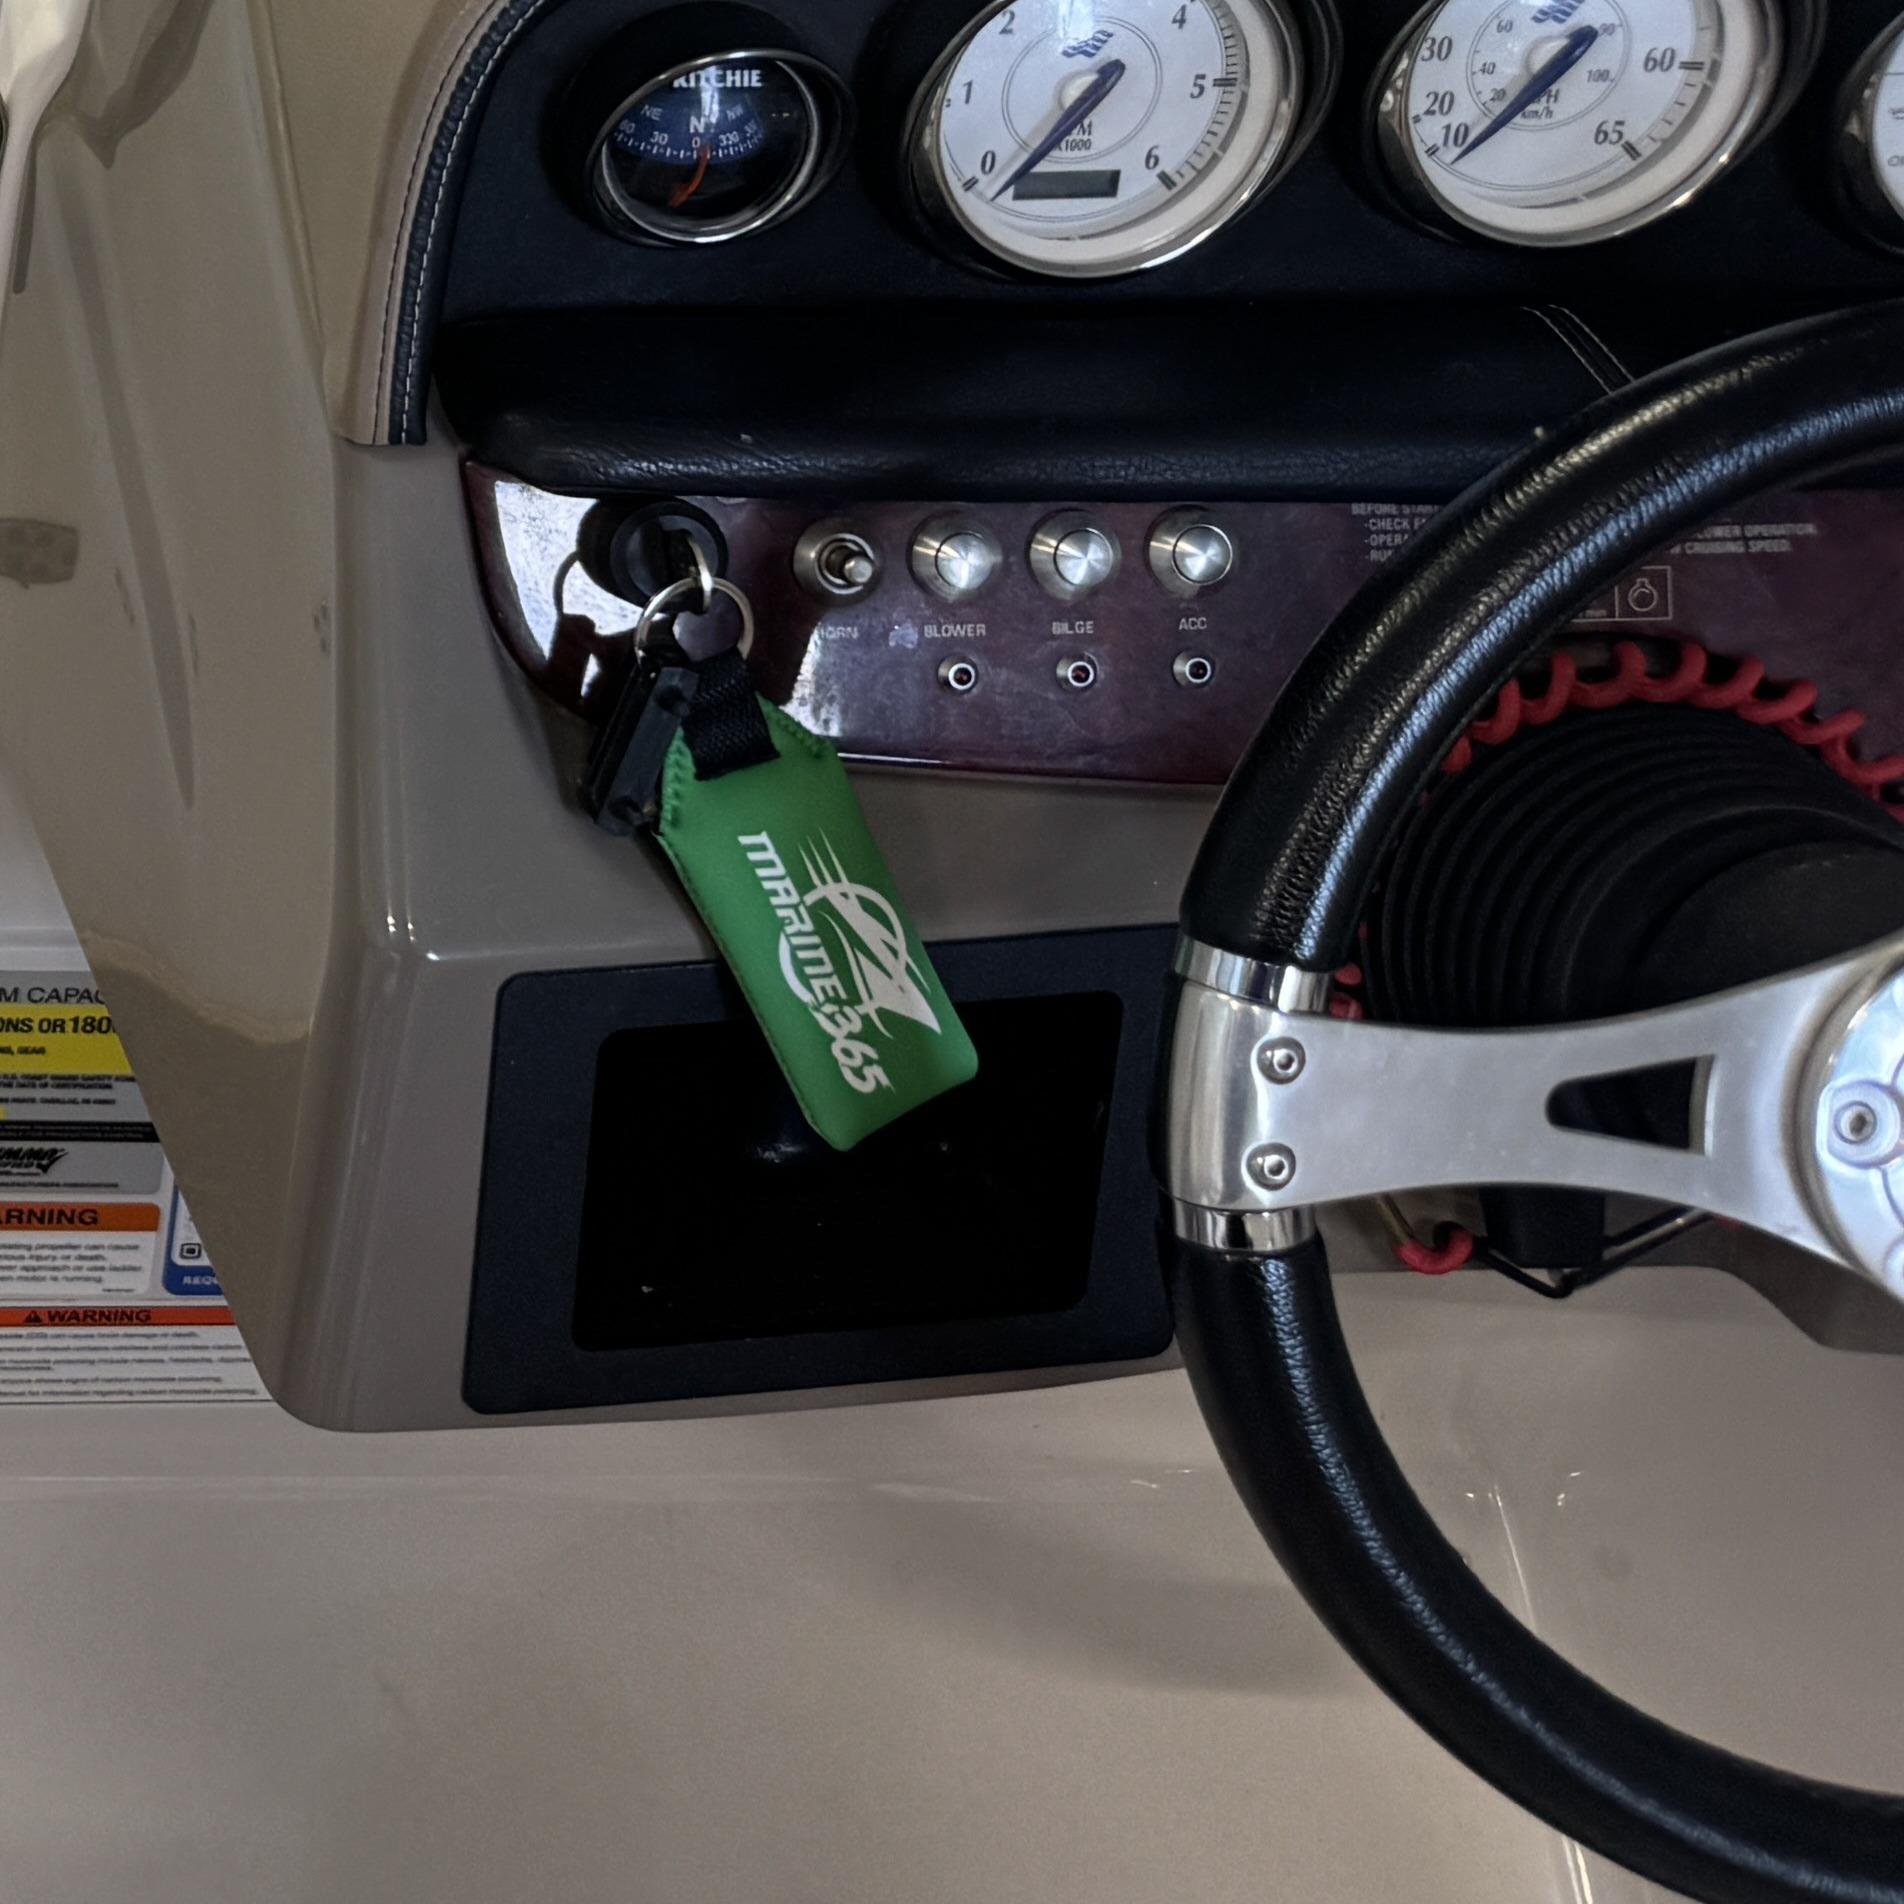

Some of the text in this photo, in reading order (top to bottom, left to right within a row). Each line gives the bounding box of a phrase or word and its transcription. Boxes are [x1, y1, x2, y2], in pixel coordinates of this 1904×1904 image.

[999, 10, 1016, 35] 2
[1171, 4, 1188, 29] 4
[1496, 20, 1513, 33] 60
[1420, 36, 1453, 62] 30
[1478, 62, 1495, 75] 40
[1644, 47, 1676, 72] 60
[673, 69, 762, 88] RITCHIE
[1586, 69, 1610, 83] 100
[962, 80, 974, 104] 1
[1190, 74, 1207, 99] 5
[1489, 89, 1506, 101] 20
[1424, 90, 1455, 116] 20
[641, 104, 663, 121] NE
[689, 116, 705, 133] N
[1594, 120, 1626, 145] 65
[650, 131, 669, 145] 30
[692, 136, 701, 147] 0
[719, 131, 740, 146] 330
[1441, 122, 1469, 148] 10
[980, 150, 997, 175] 0
[1144, 145, 1160, 170] 6
[1696, 524, 1741, 539] LOWER
[924, 623, 986, 638] BLOWER
[1052, 621, 1094, 635] BILGE
[1178, 616, 1208, 631] ACC
[738, 831, 896, 1094] MARINE365
[38, 1018, 66, 1034] OR
[69, 1015, 116, 1035] 180
[47, 1309, 152, 1323] WARNING
